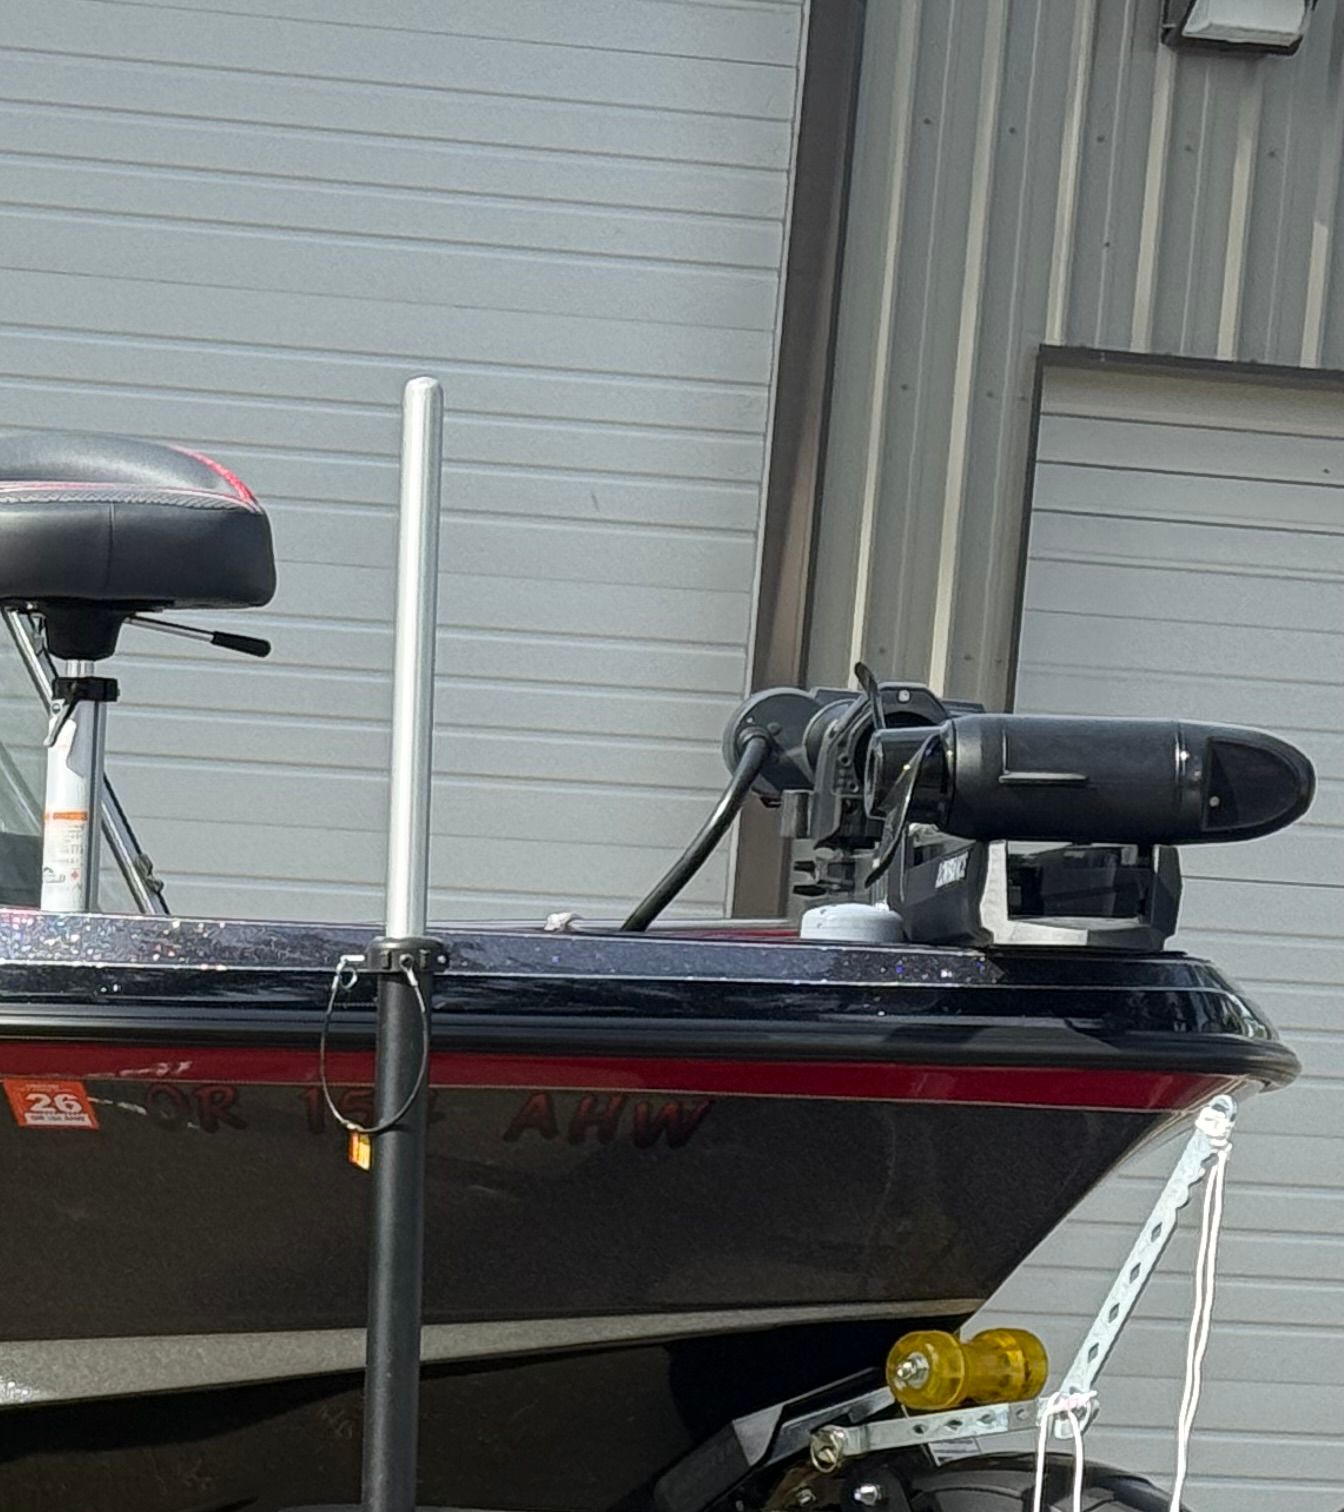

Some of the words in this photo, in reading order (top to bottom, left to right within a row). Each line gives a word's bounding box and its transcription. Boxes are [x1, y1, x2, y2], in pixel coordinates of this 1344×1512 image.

[25, 1092, 83, 1114] 26
[146, 1084, 247, 1134] OR
[503, 1091, 711, 1150] AHW
